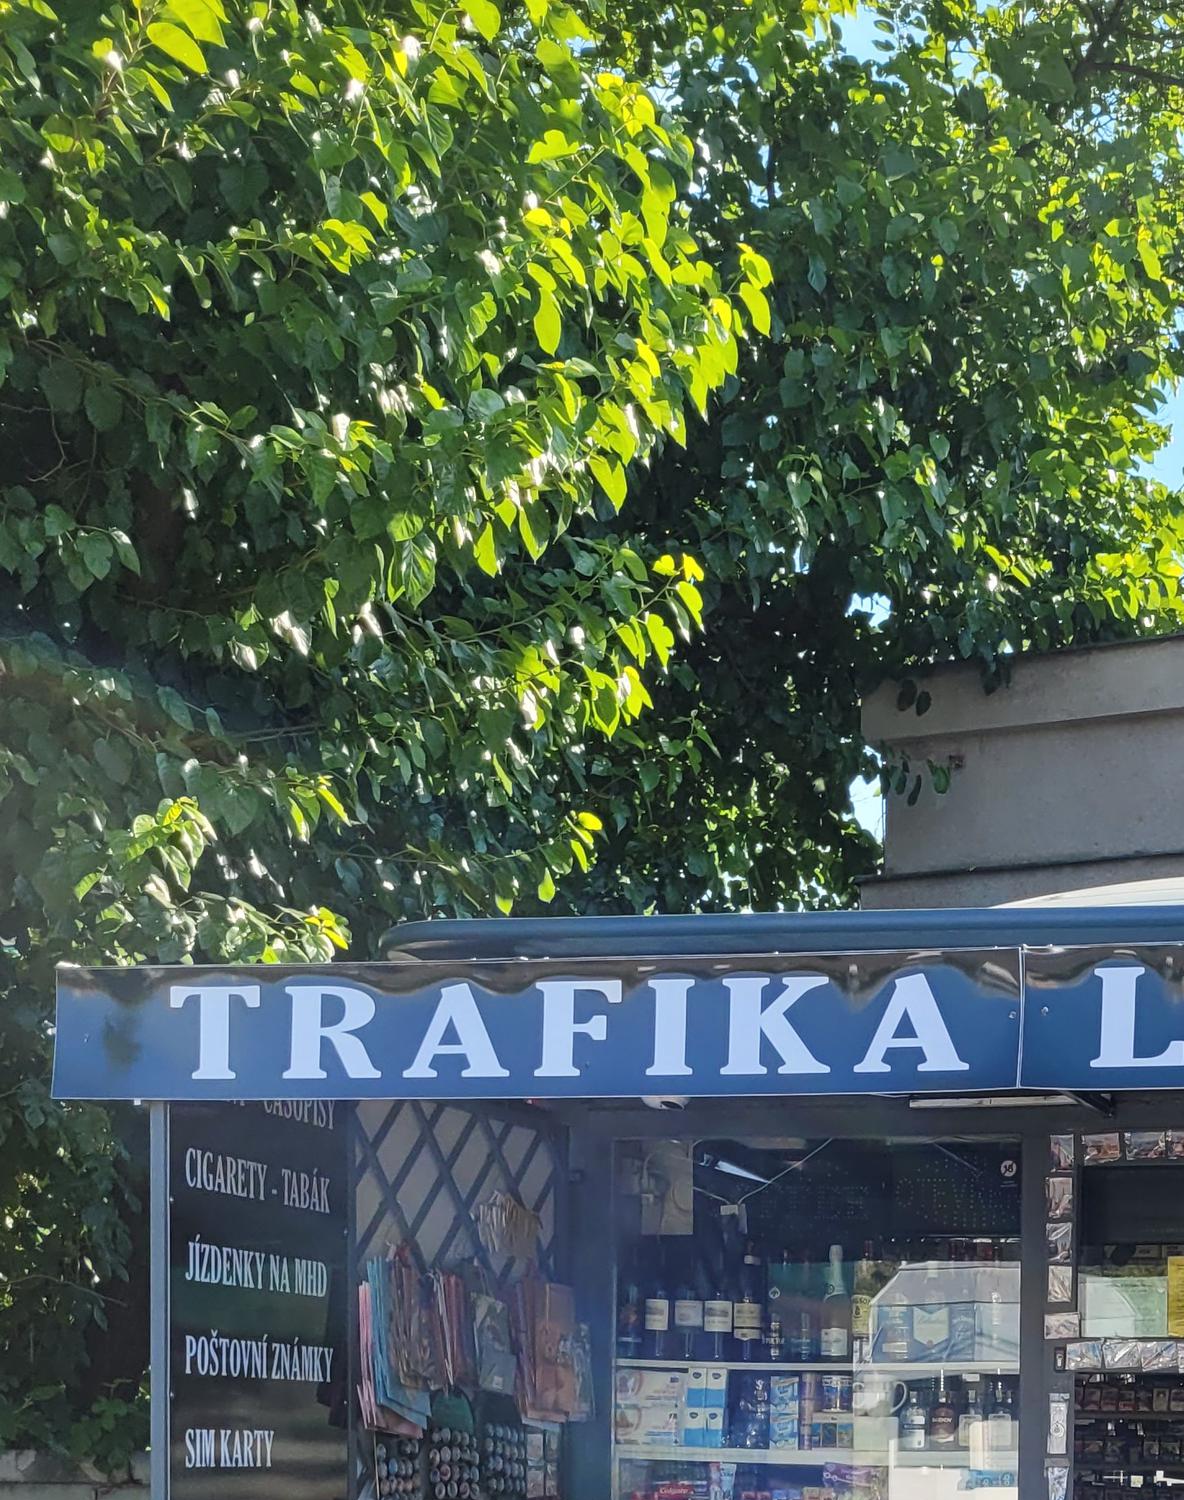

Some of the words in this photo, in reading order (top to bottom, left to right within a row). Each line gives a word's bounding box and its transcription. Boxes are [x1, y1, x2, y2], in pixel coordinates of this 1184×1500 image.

[169, 973, 971, 1081] TRAFIKA
[185, 1147, 268, 1200] CIGARETY
[282, 1167, 331, 1214] TABÁK
[185, 1233, 266, 1290] JÍZDENKY
[269, 1253, 290, 1294] NA
[294, 1257, 328, 1298] MHD
[185, 1328, 268, 1379] POŠTOVNÍ
[271, 1336, 333, 1383] ZNÁMKY
[185, 1428, 216, 1468] SIM
[220, 1430, 275, 1468] KARTY
